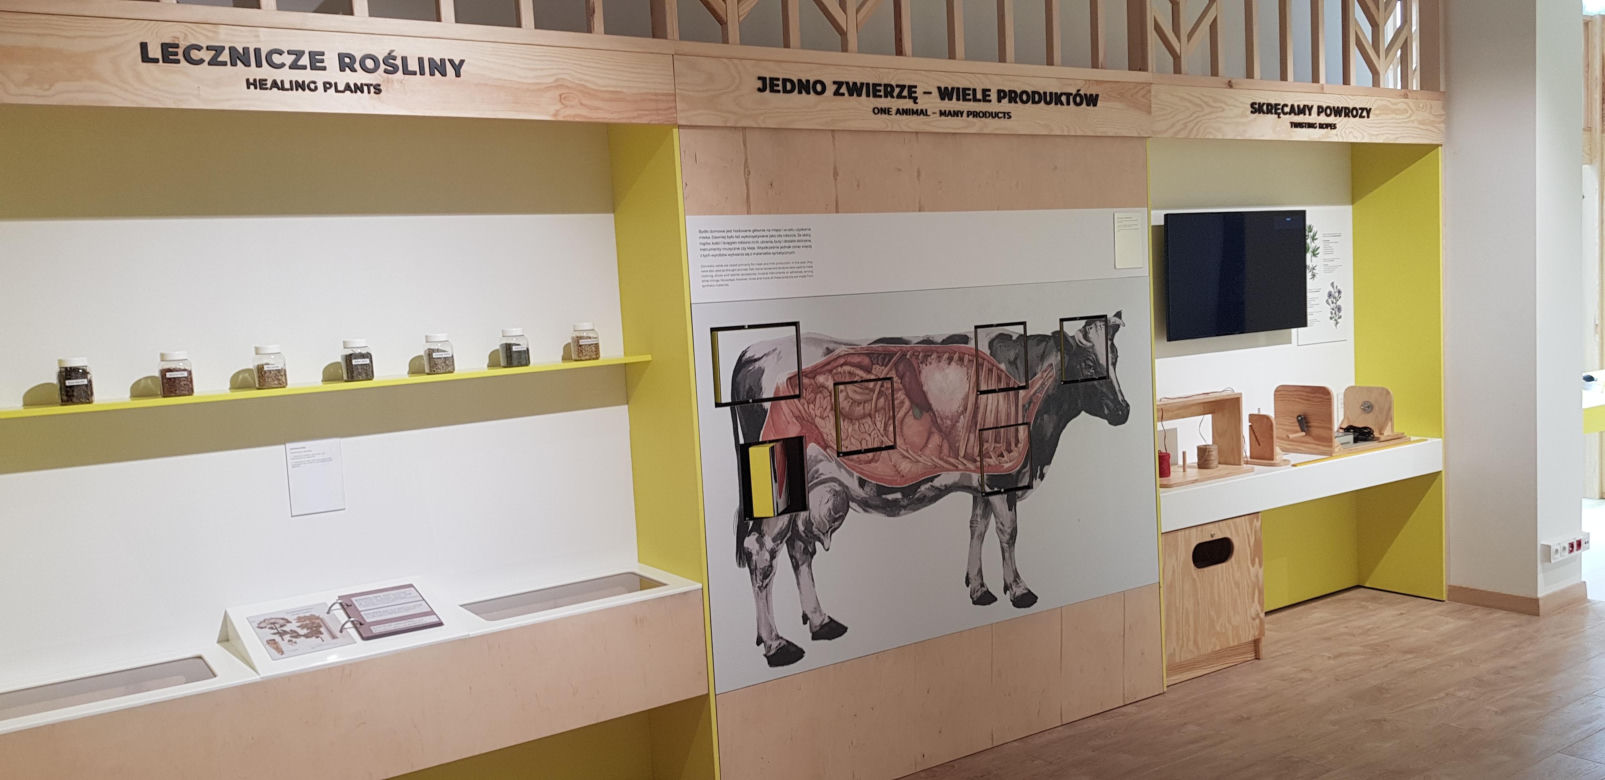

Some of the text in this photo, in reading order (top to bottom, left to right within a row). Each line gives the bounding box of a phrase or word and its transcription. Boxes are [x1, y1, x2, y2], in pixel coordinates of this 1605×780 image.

[139, 42, 465, 78] LECZNICZE ROŚLINY
[246, 78, 382, 94] HEALING PLANTS
[757, 76, 826, 95] JEDNO
[833, 81, 918, 104] ZWIERZĘ
[937, 86, 991, 103] WIELE
[997, 89, 1099, 107] PRODUKTÓW
[872, 106, 892, 115] ONE
[895, 108, 930, 116] ANIMAL
[939, 110, 964, 118] MANY
[967, 110, 1011, 119] PRODUCTS
[1250, 102, 1371, 118] SKRĘCAMY POWROZY
